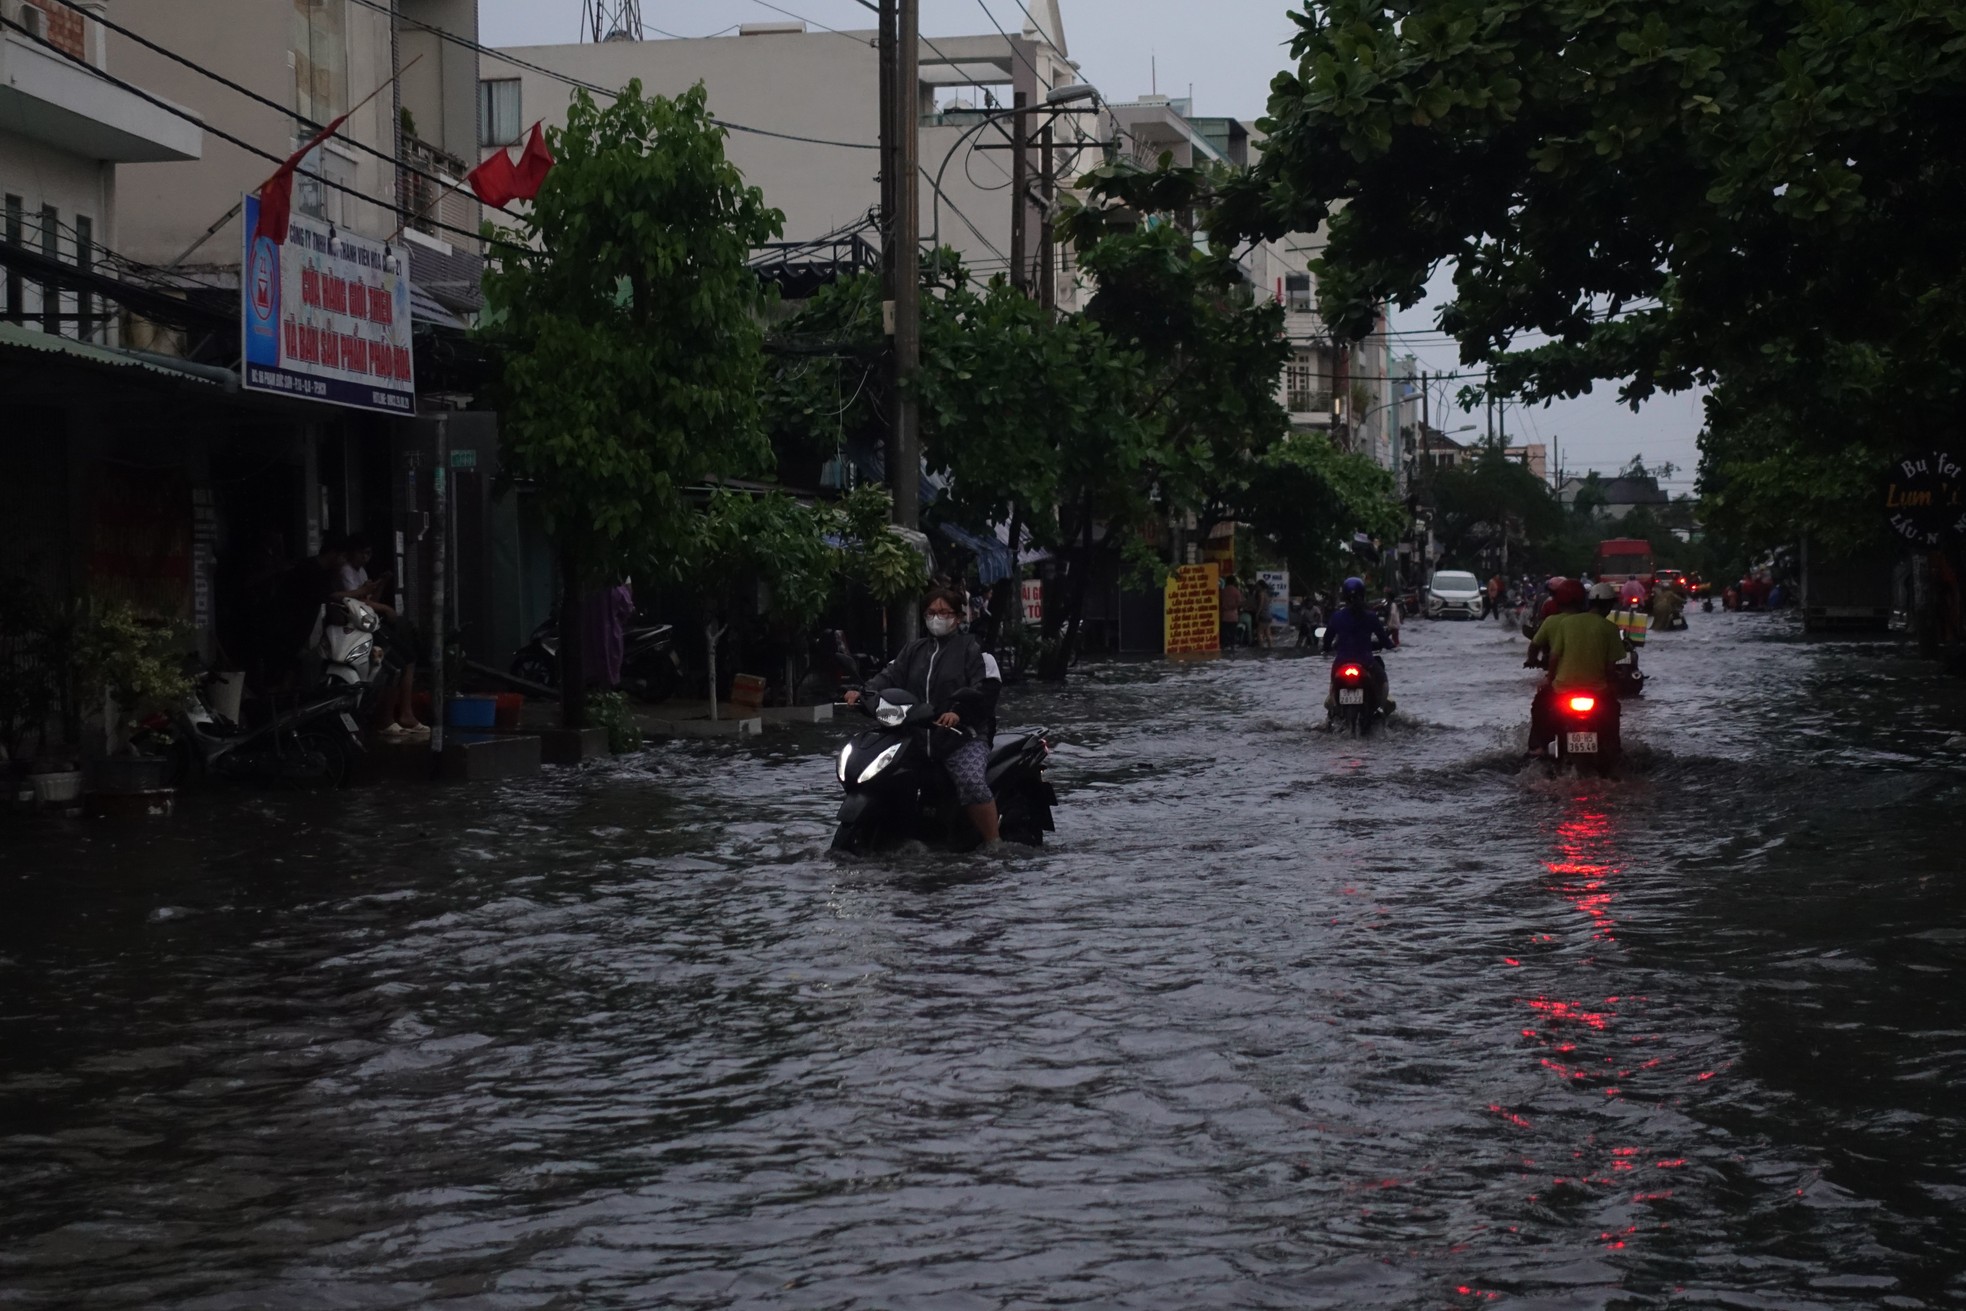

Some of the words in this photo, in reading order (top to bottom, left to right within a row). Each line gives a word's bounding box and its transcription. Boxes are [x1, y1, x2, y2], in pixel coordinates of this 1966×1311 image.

[305, 230, 312, 250] TY
[321, 267, 347, 316] HÀNG
[283, 313, 298, 360] VÀ
[298, 317, 320, 365] BÁN
[1900, 450, 1962, 479] Bufet
